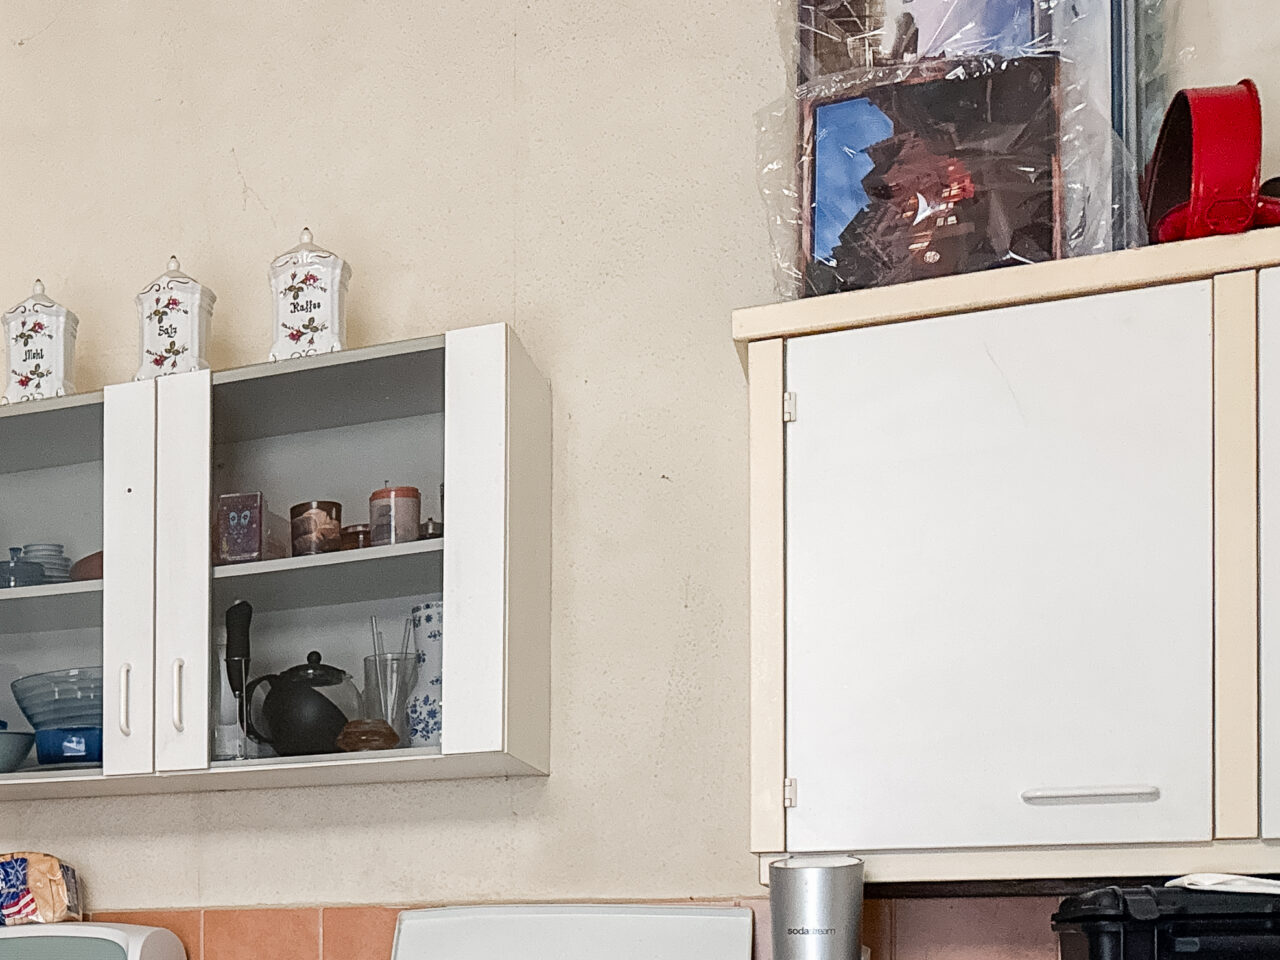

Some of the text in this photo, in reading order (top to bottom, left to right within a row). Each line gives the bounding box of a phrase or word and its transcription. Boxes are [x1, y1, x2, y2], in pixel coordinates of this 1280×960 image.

[290, 300, 321, 313] Kaffee
[158, 324, 177, 338] Salz
[22, 349, 44, 362] Mehl
[787, 927, 836, 935] sodaream
